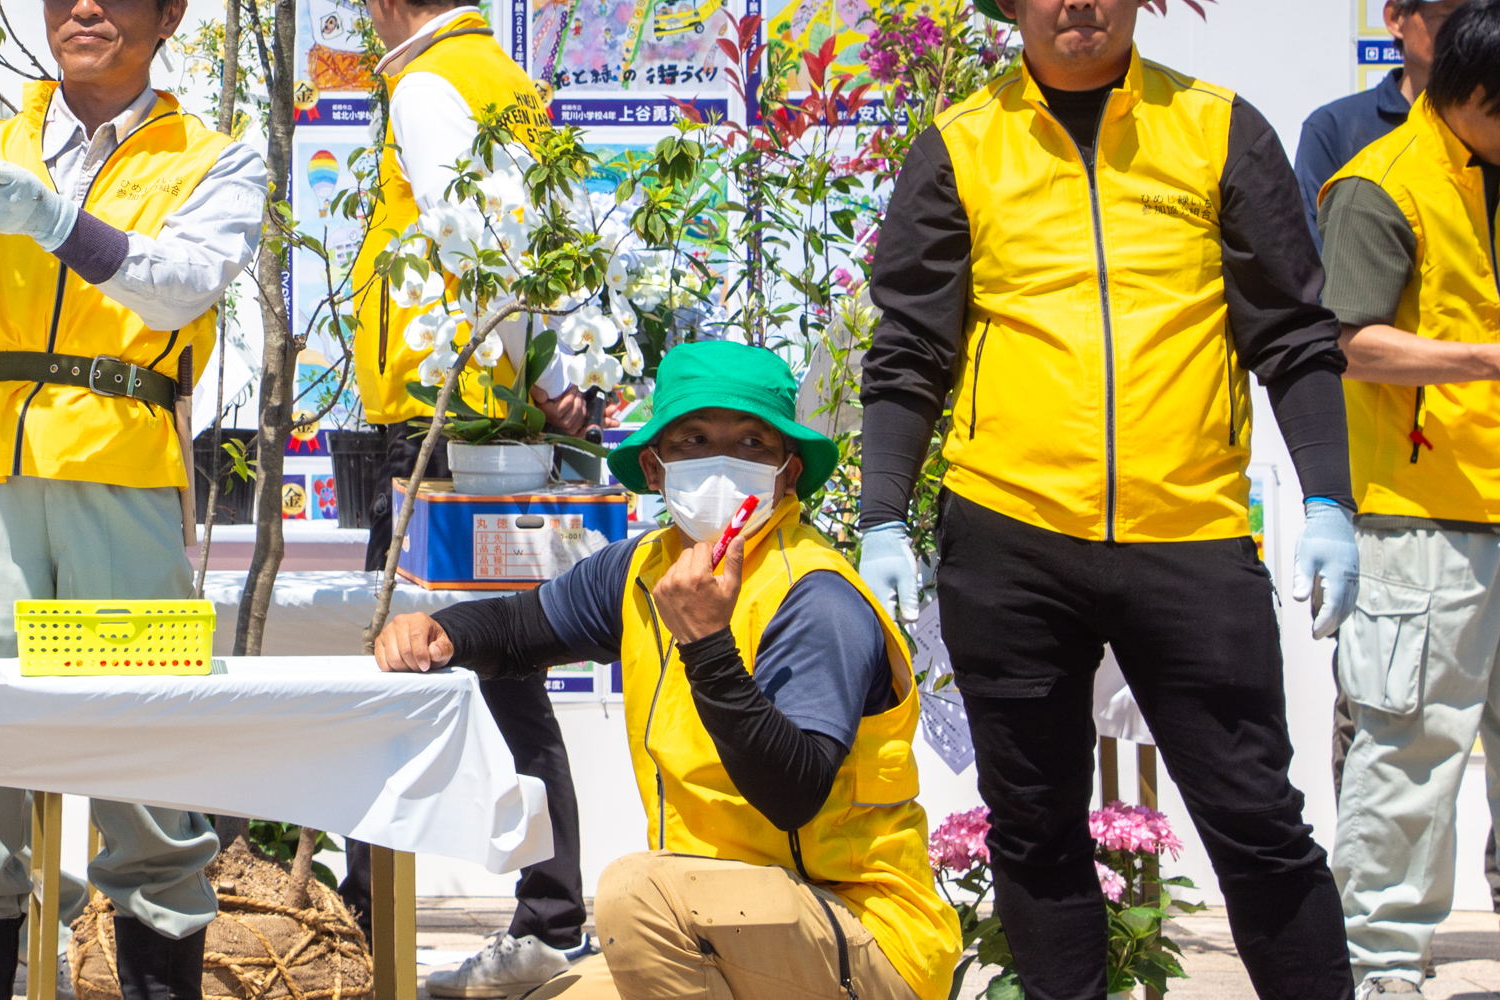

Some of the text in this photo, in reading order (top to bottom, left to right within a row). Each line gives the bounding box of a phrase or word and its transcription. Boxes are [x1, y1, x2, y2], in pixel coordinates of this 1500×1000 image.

[294, 82, 314, 103] 金
[561, 111, 617, 121] 荒川小学校4年
[283, 487, 302, 508] 金
[479, 534, 503, 543] 行先
[479, 545, 503, 554] 品名
